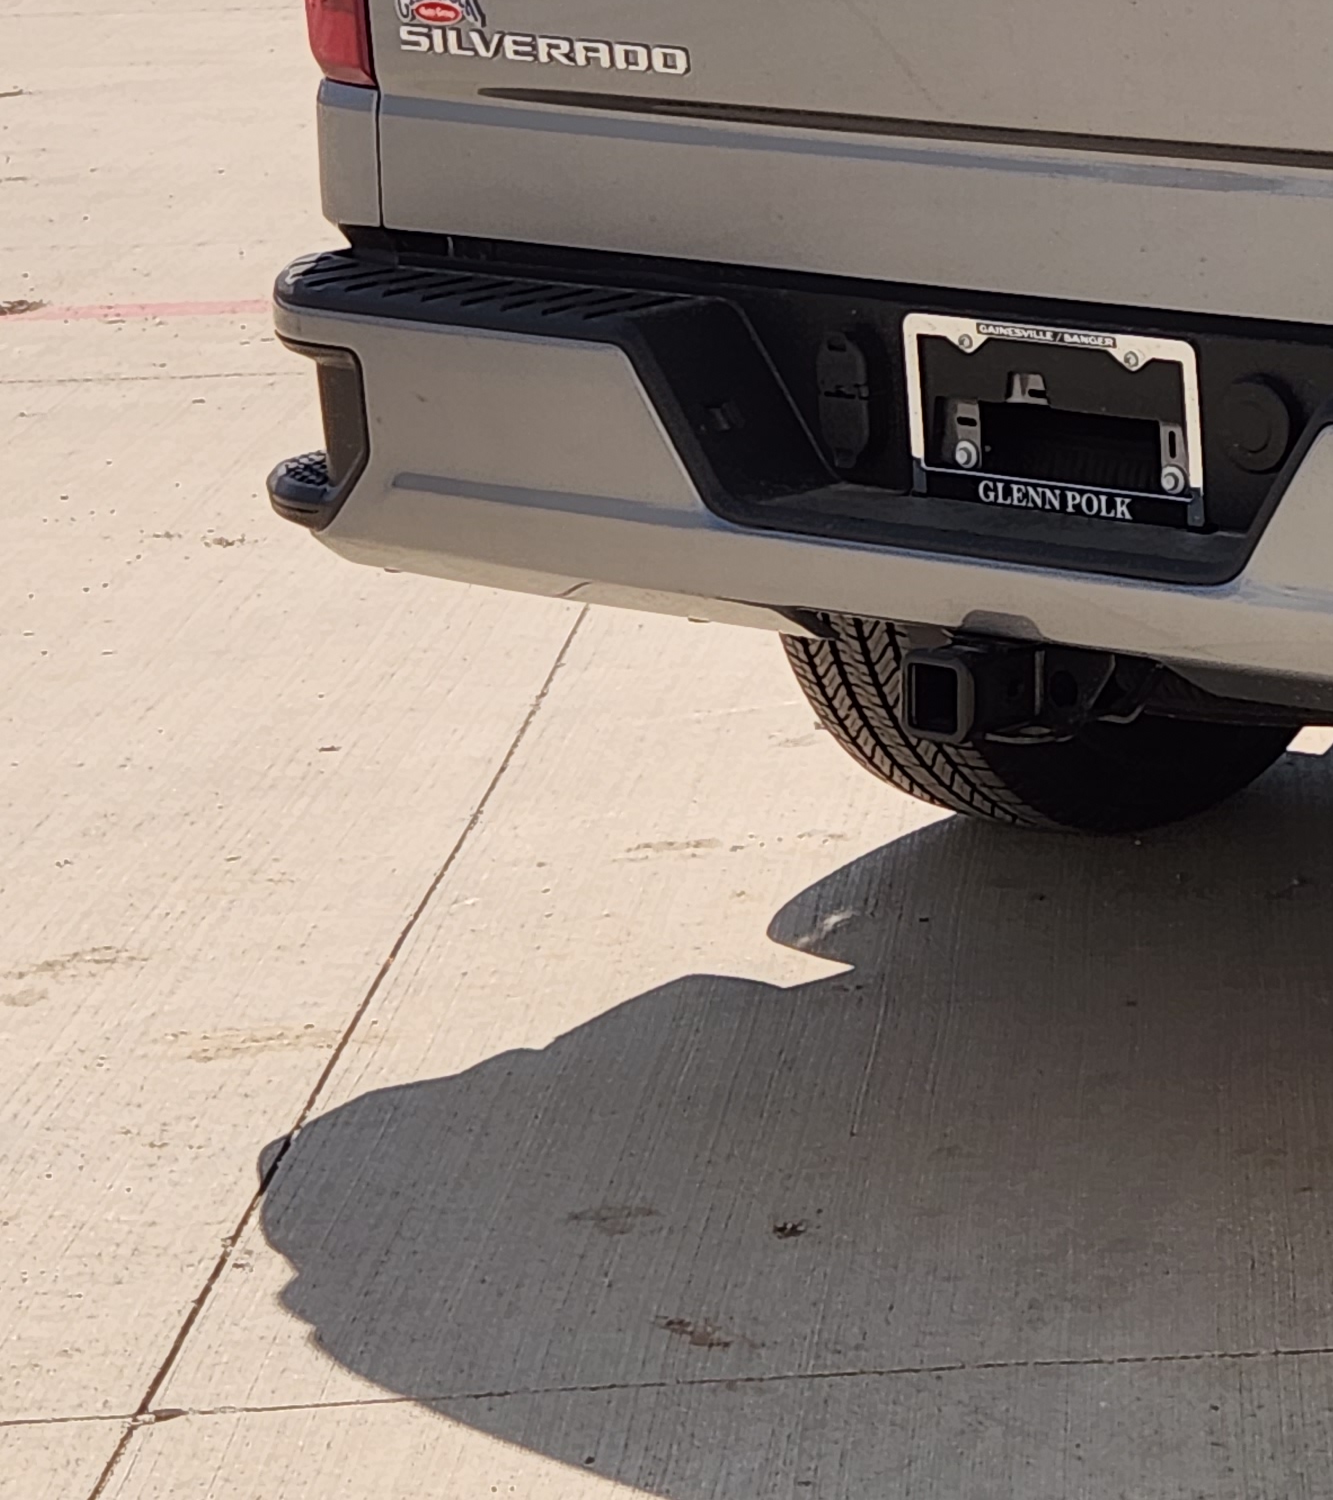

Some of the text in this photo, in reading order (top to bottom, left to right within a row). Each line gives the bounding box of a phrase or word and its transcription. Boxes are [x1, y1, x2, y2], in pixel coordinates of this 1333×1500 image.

[399, 23, 691, 75] SILVERADO
[978, 324, 1055, 341] GAINESVILLE
[977, 479, 1133, 520] GLENN POLK
